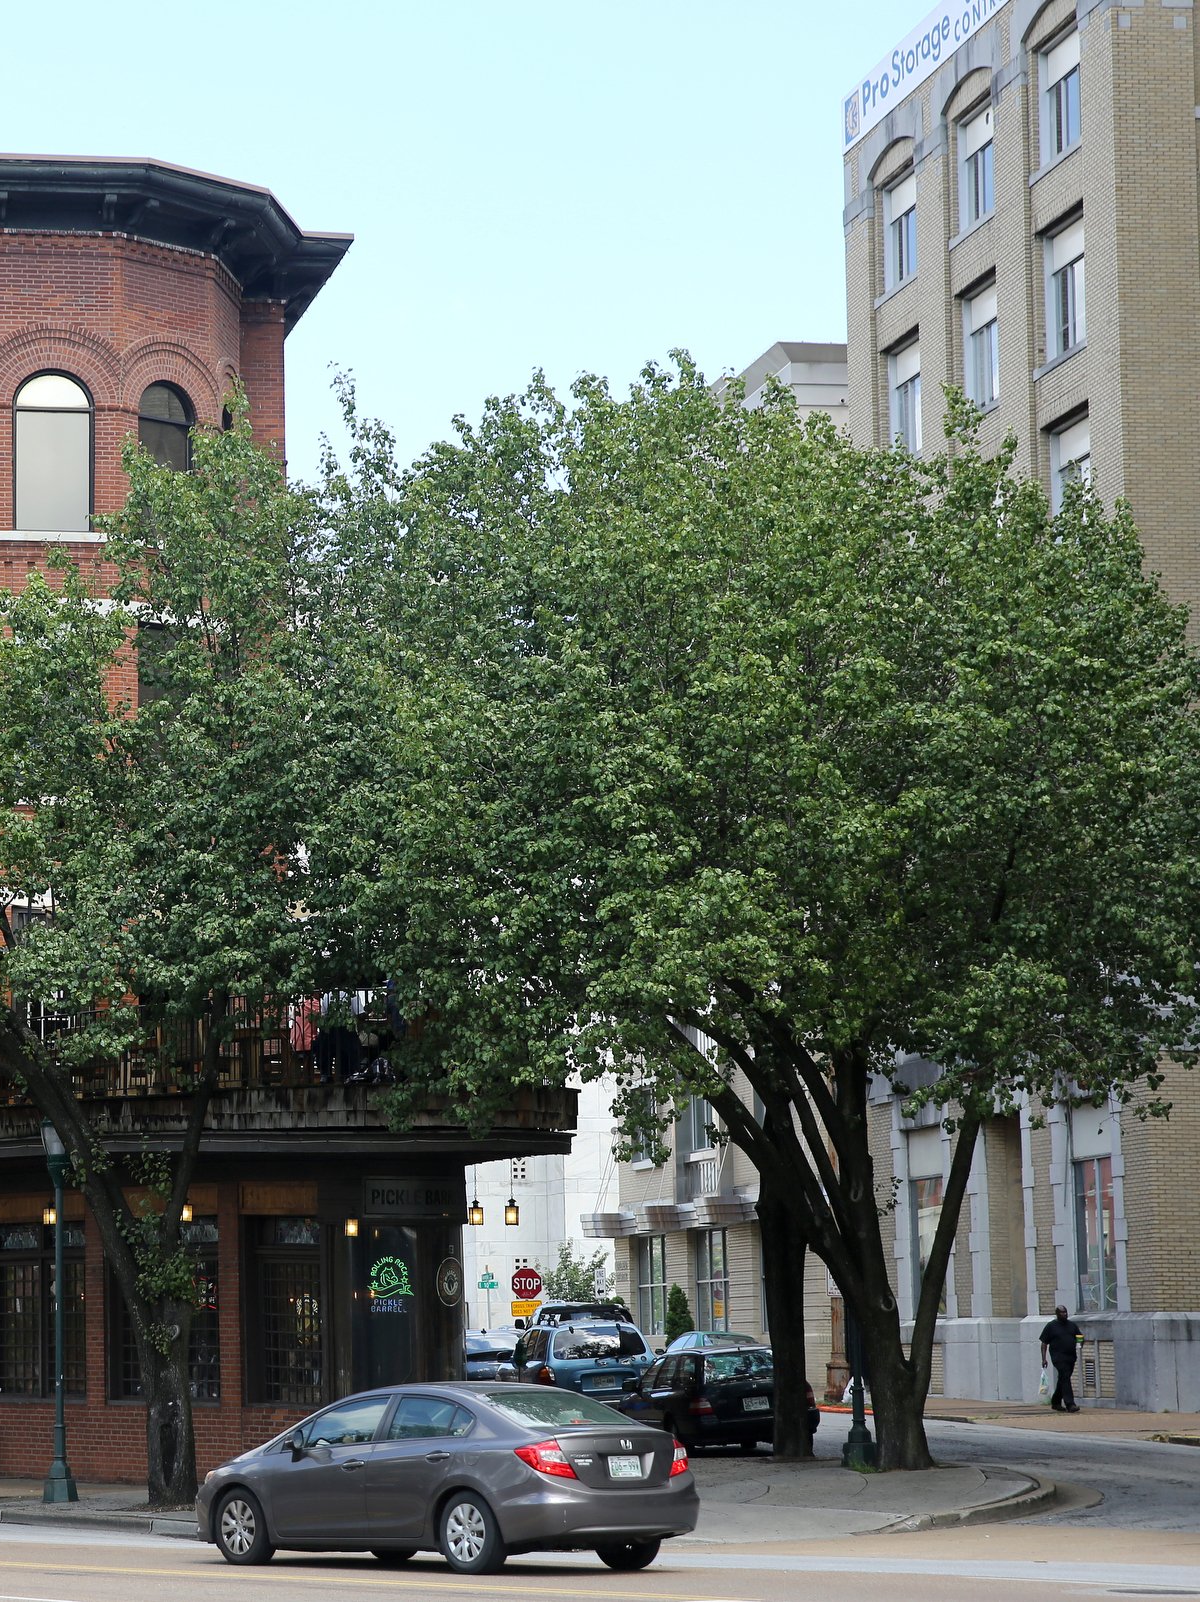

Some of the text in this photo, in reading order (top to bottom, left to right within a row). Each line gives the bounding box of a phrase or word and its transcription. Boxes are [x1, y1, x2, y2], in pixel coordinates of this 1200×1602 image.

[370, 1255, 409, 1277] ROLLING ROCK
[513, 1277, 541, 1290] STOP
[373, 1298, 403, 1306] PICKLE
